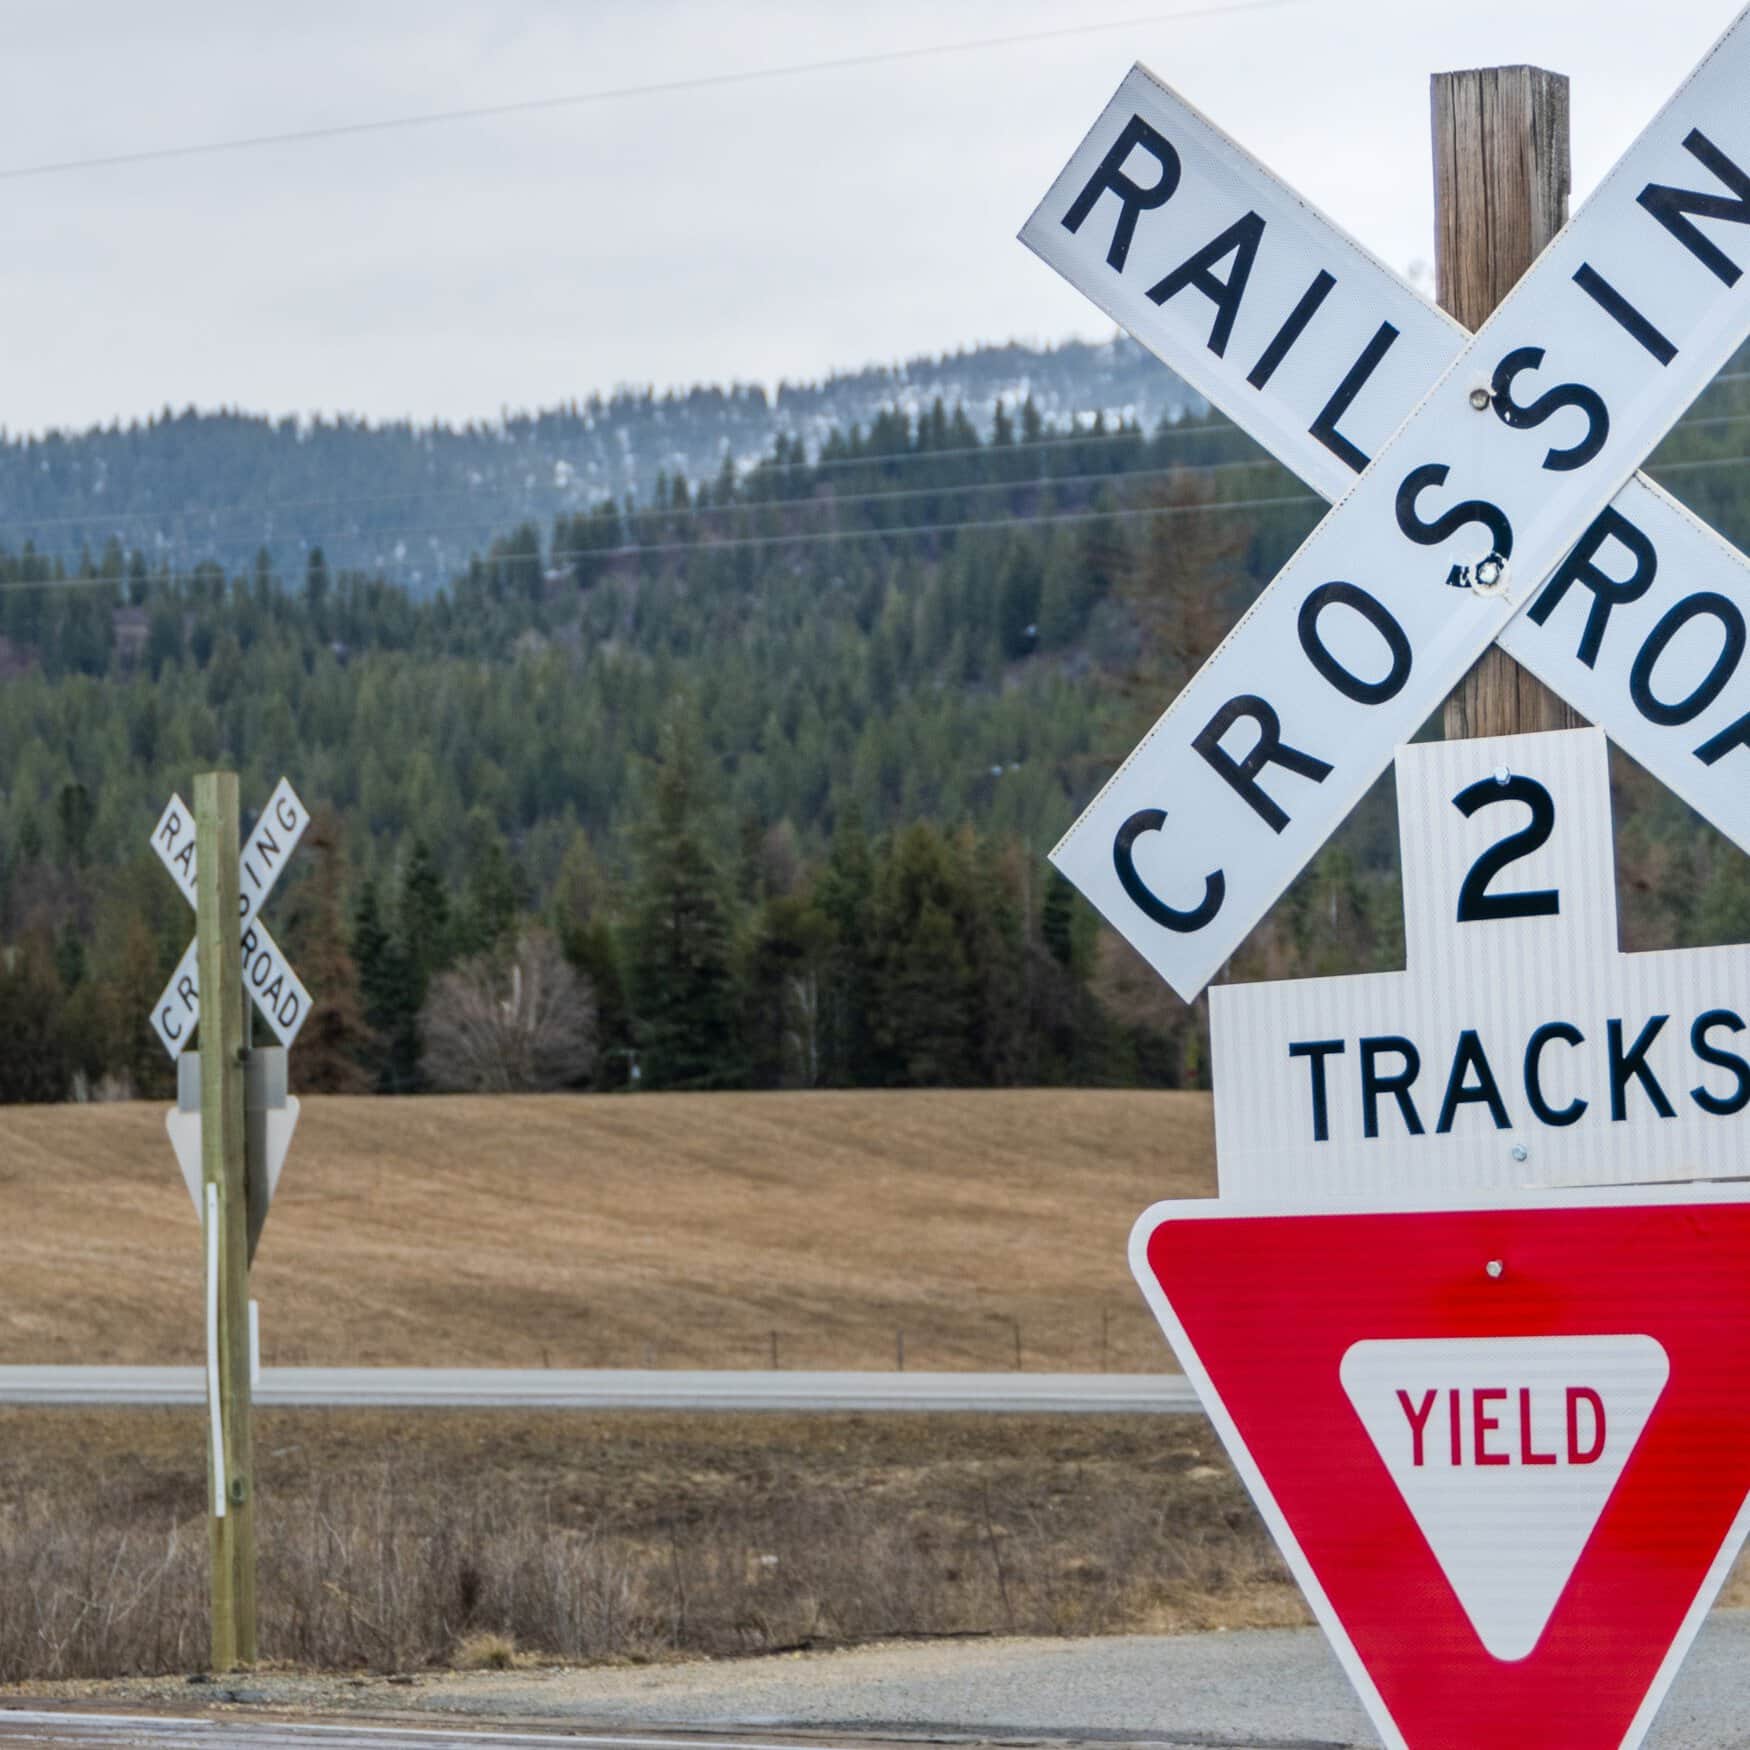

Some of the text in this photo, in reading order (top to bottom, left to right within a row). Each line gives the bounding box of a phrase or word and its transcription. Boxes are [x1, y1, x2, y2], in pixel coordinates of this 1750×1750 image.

[1061, 113, 1400, 474] RAIL
[1452, 774, 1560, 923] 2
[1289, 1008, 1750, 1141] TRACKS
[1396, 1387, 1606, 1466] YIELD
